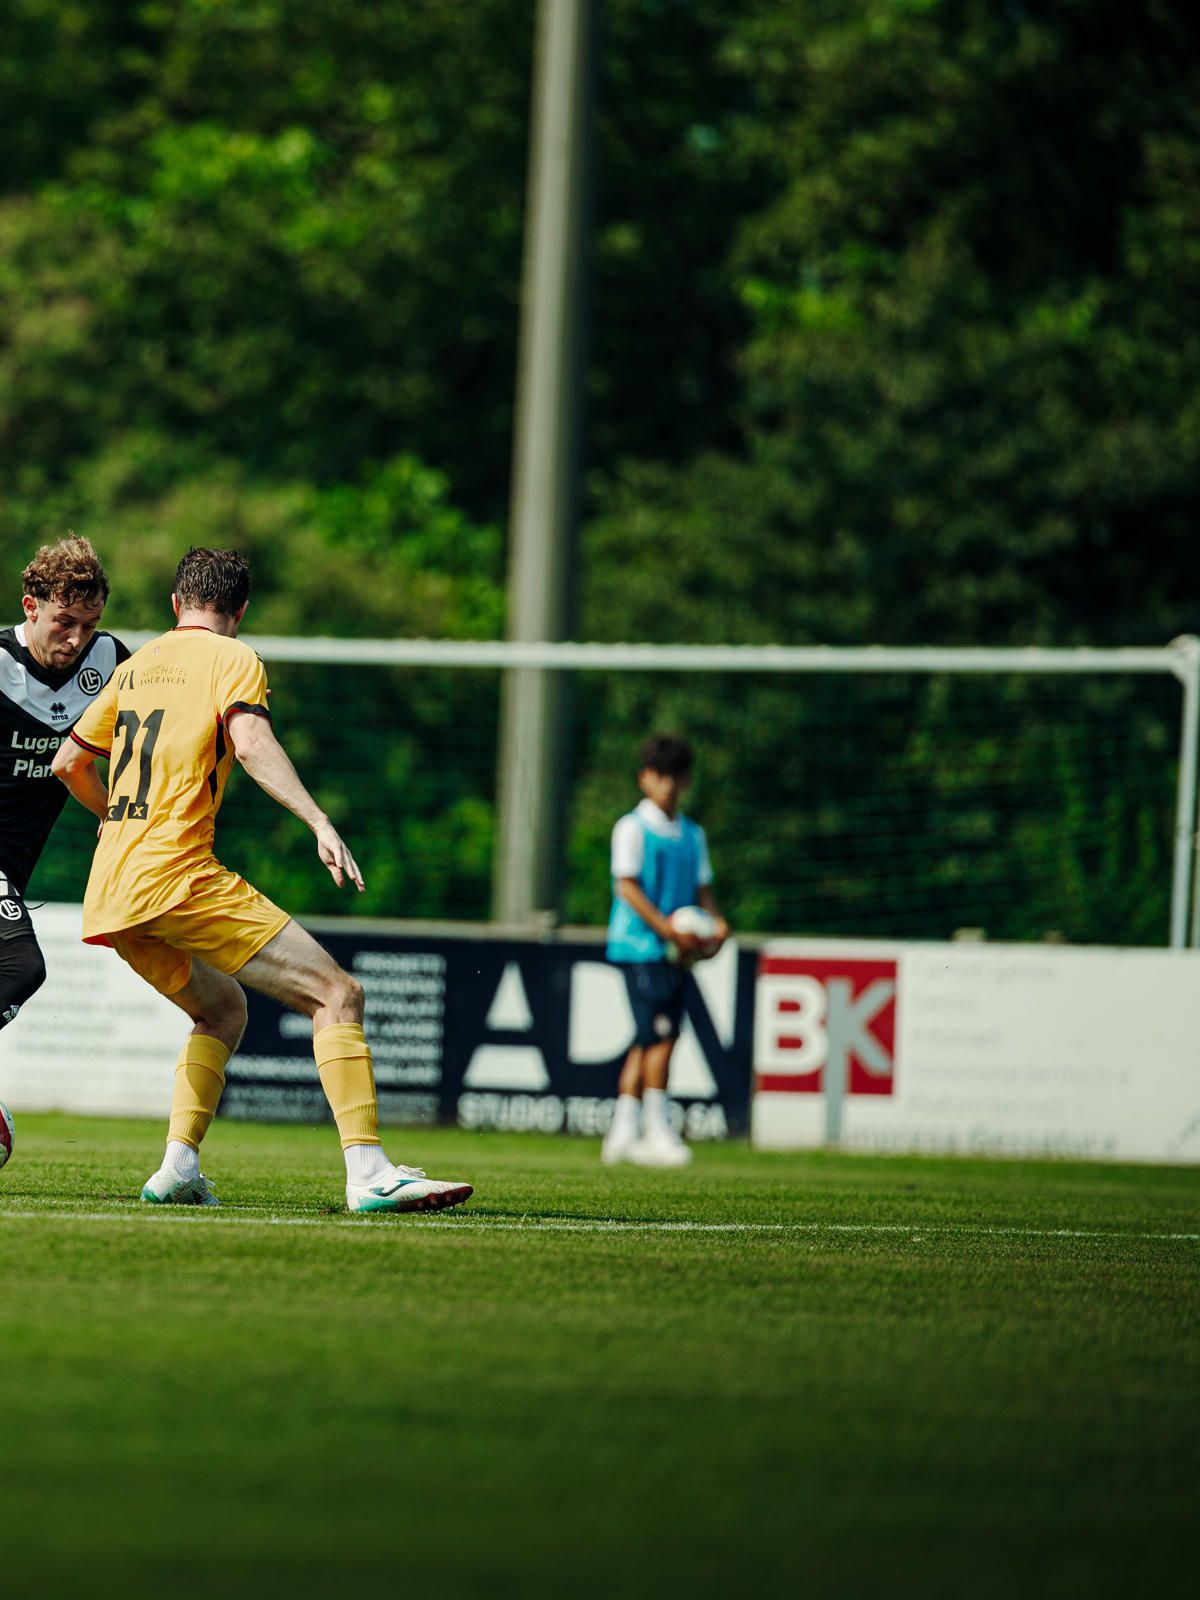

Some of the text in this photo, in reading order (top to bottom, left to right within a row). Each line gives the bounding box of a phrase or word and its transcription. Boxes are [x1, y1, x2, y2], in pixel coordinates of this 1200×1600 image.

[106, 709, 165, 822] 21
[457, 1091, 565, 1133] STUDIO
[566, 1095, 685, 1136] TECO
